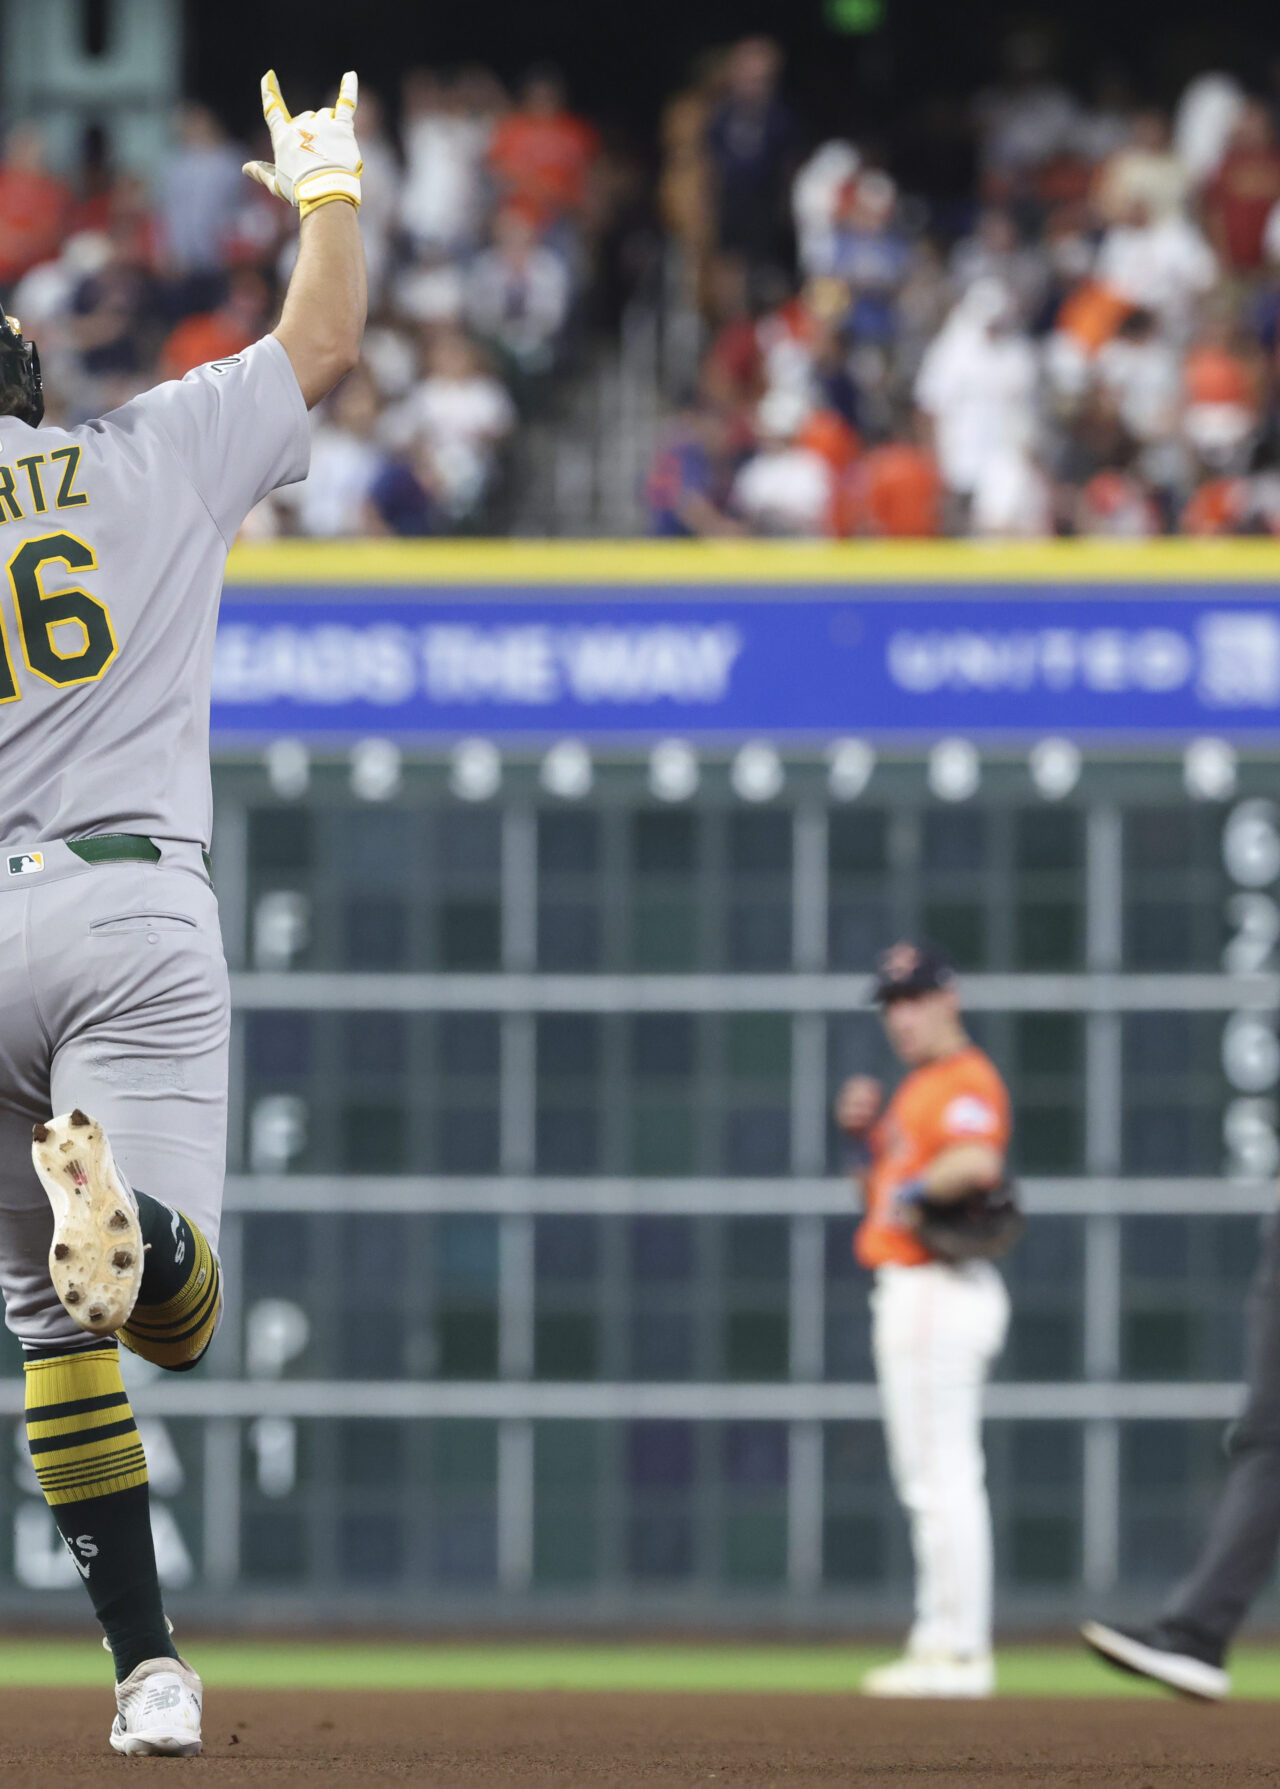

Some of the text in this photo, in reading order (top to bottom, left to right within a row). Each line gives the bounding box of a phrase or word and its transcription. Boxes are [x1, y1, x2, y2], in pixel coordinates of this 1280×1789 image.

[208, 619, 740, 706] EADS THE WAY
[885, 628, 1192, 694] UNITED
